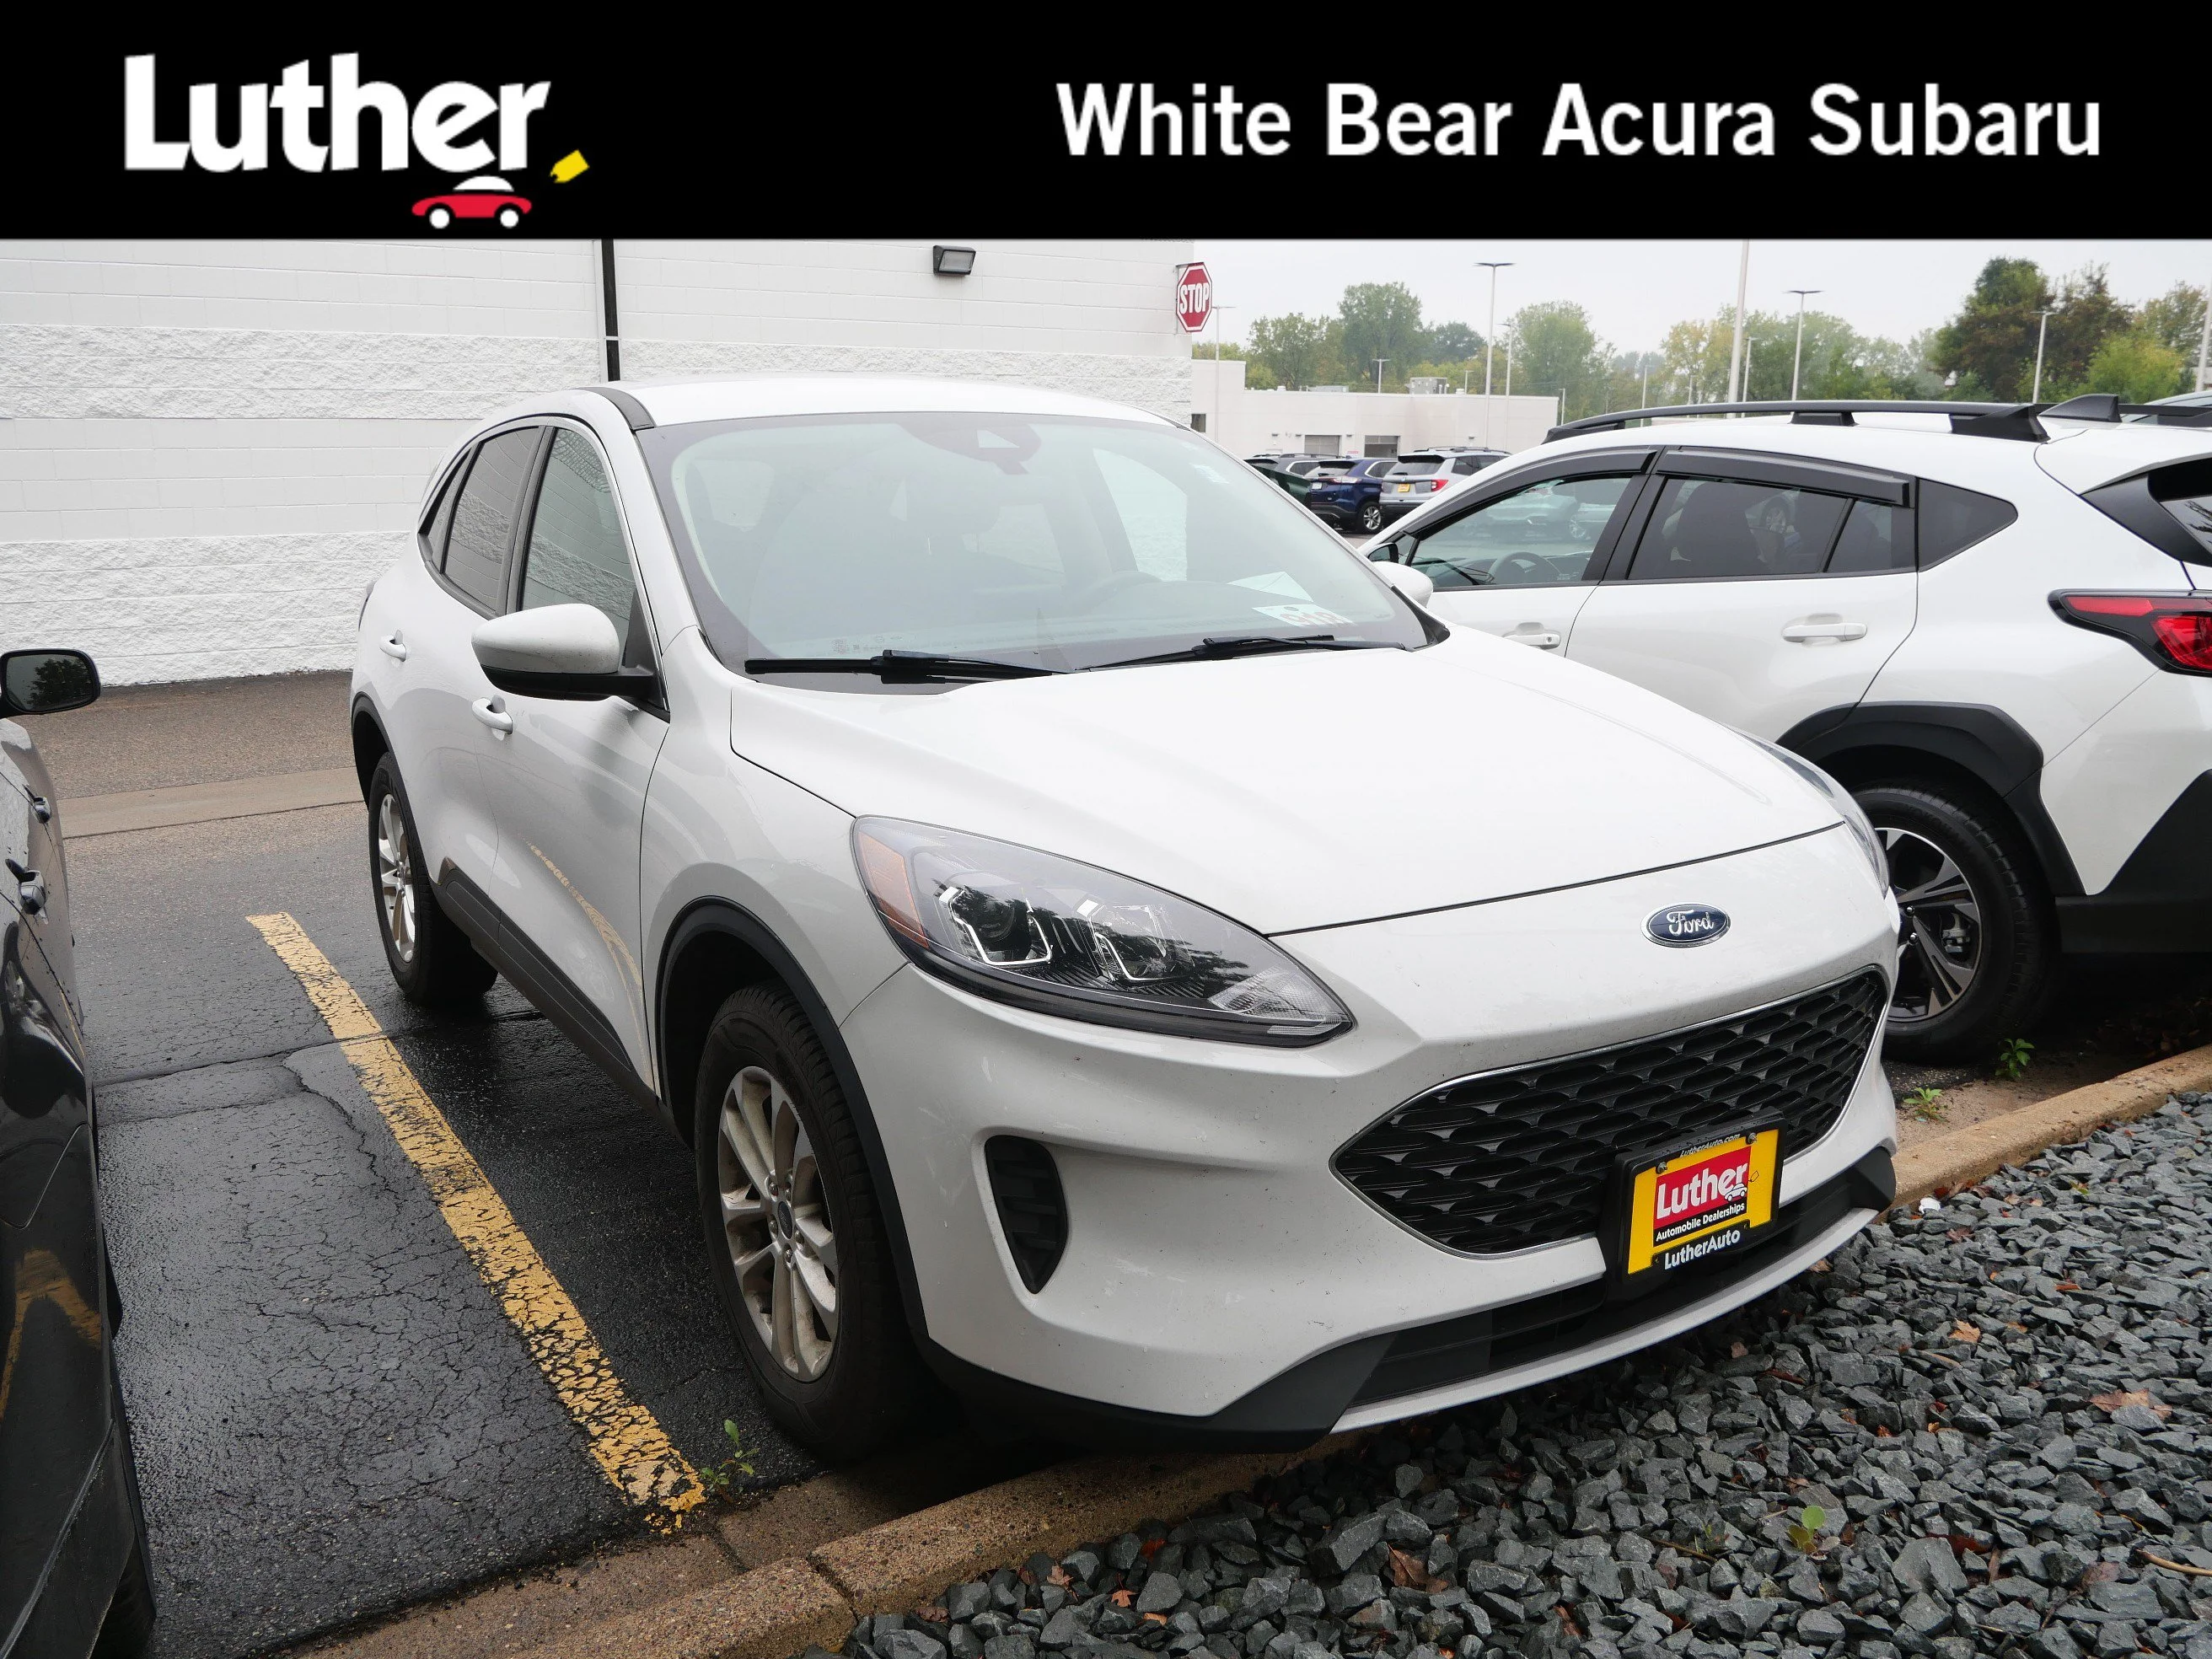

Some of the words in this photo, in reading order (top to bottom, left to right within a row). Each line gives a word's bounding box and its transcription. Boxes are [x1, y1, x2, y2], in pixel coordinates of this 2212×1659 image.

[1180, 282, 1210, 314] STOP
[1666, 910, 1715, 936] Ford
[1679, 1133, 1741, 1157] LutherAuto.com
[1656, 1162, 1748, 1220] Luther
[1656, 1218, 1701, 1243] Automobile
[1703, 1202, 1745, 1225] Dealerships
[1664, 1229, 1741, 1270] LutherAuto
